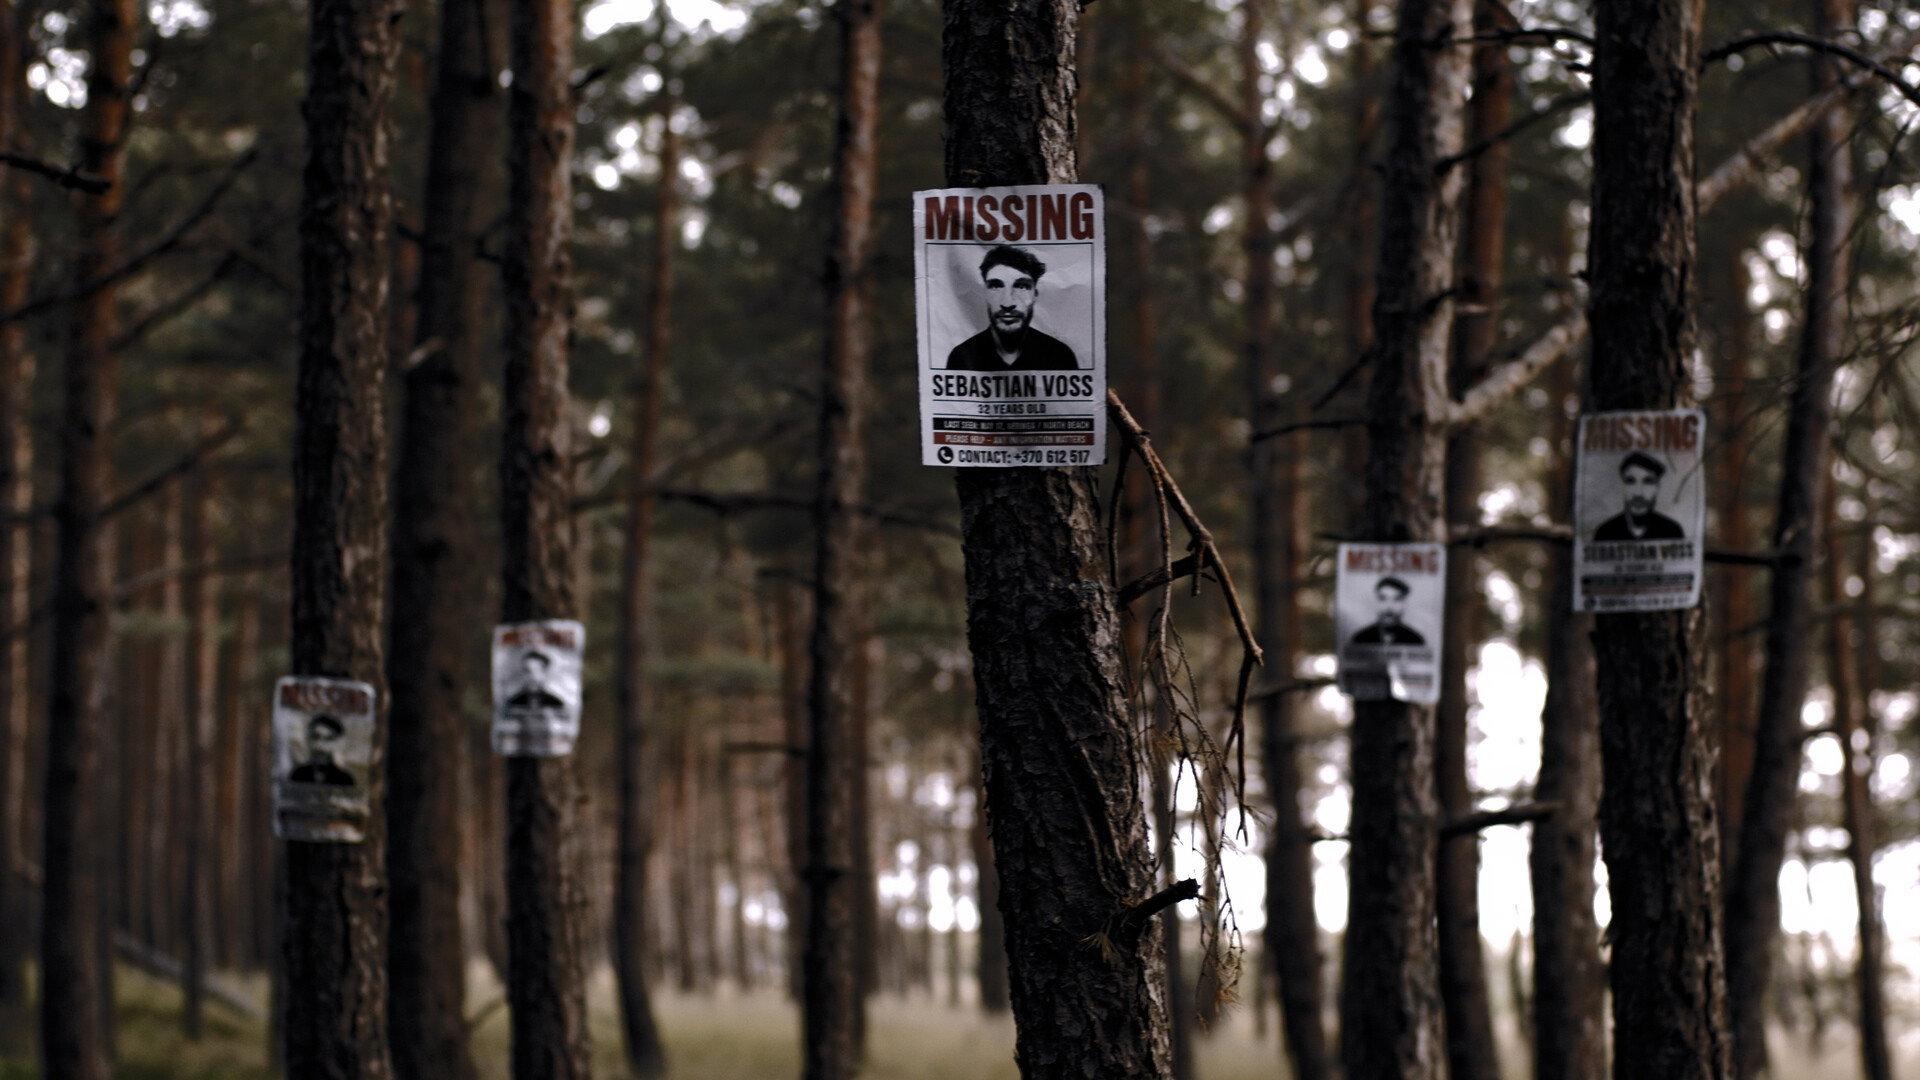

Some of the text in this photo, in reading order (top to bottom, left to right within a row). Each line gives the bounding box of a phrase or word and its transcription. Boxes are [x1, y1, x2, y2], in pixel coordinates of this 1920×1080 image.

[925, 192, 1095, 241] MISSING
[932, 374, 1093, 398] SEBASTIAN VOSS
[978, 404, 1047, 414] 32 YEARS OLD
[1067, 421, 1091, 430] BEACH
[945, 434, 969, 444] PLEASE
[970, 435, 986, 444] HELP
[1055, 435, 1087, 444] MATTERS
[1584, 416, 1698, 450] MISSING
[958, 450, 1091, 464] CONTACT: +370 612 517
